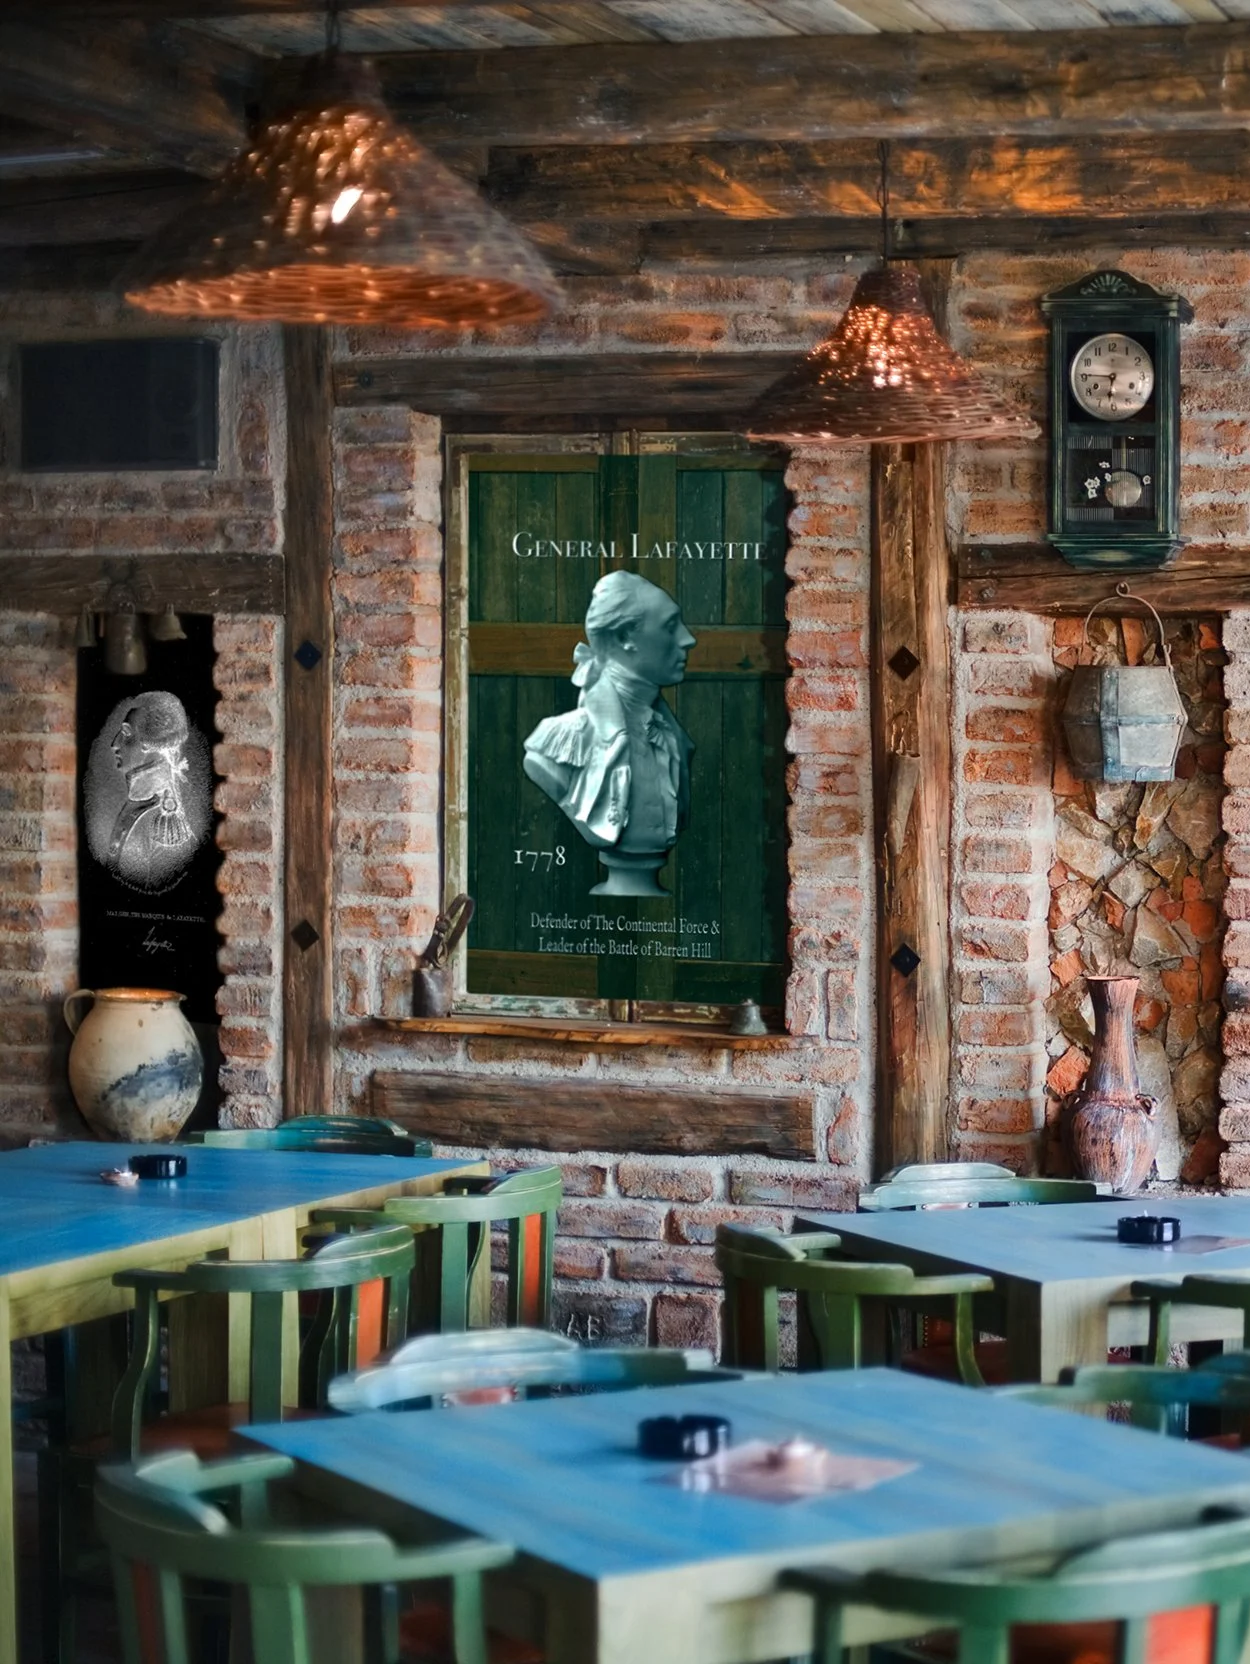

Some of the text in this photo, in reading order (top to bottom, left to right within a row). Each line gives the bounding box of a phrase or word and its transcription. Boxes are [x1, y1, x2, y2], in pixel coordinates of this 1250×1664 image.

[1095, 347, 1101, 356] 11
[1108, 342, 1117, 352] 12
[1125, 347, 1129, 356] 1
[1084, 358, 1092, 367] 10
[1134, 356, 1141, 366] 2
[1080, 373, 1088, 382] 9
[1139, 371, 1146, 381] 3
[512, 531, 768, 560] GENERAL LAFAYETTE
[514, 845, 566, 872] 1778
[531, 911, 720, 935] Defender of The Continental Force &
[539, 937, 711, 959] Leader of the Battle of Barren Hill
